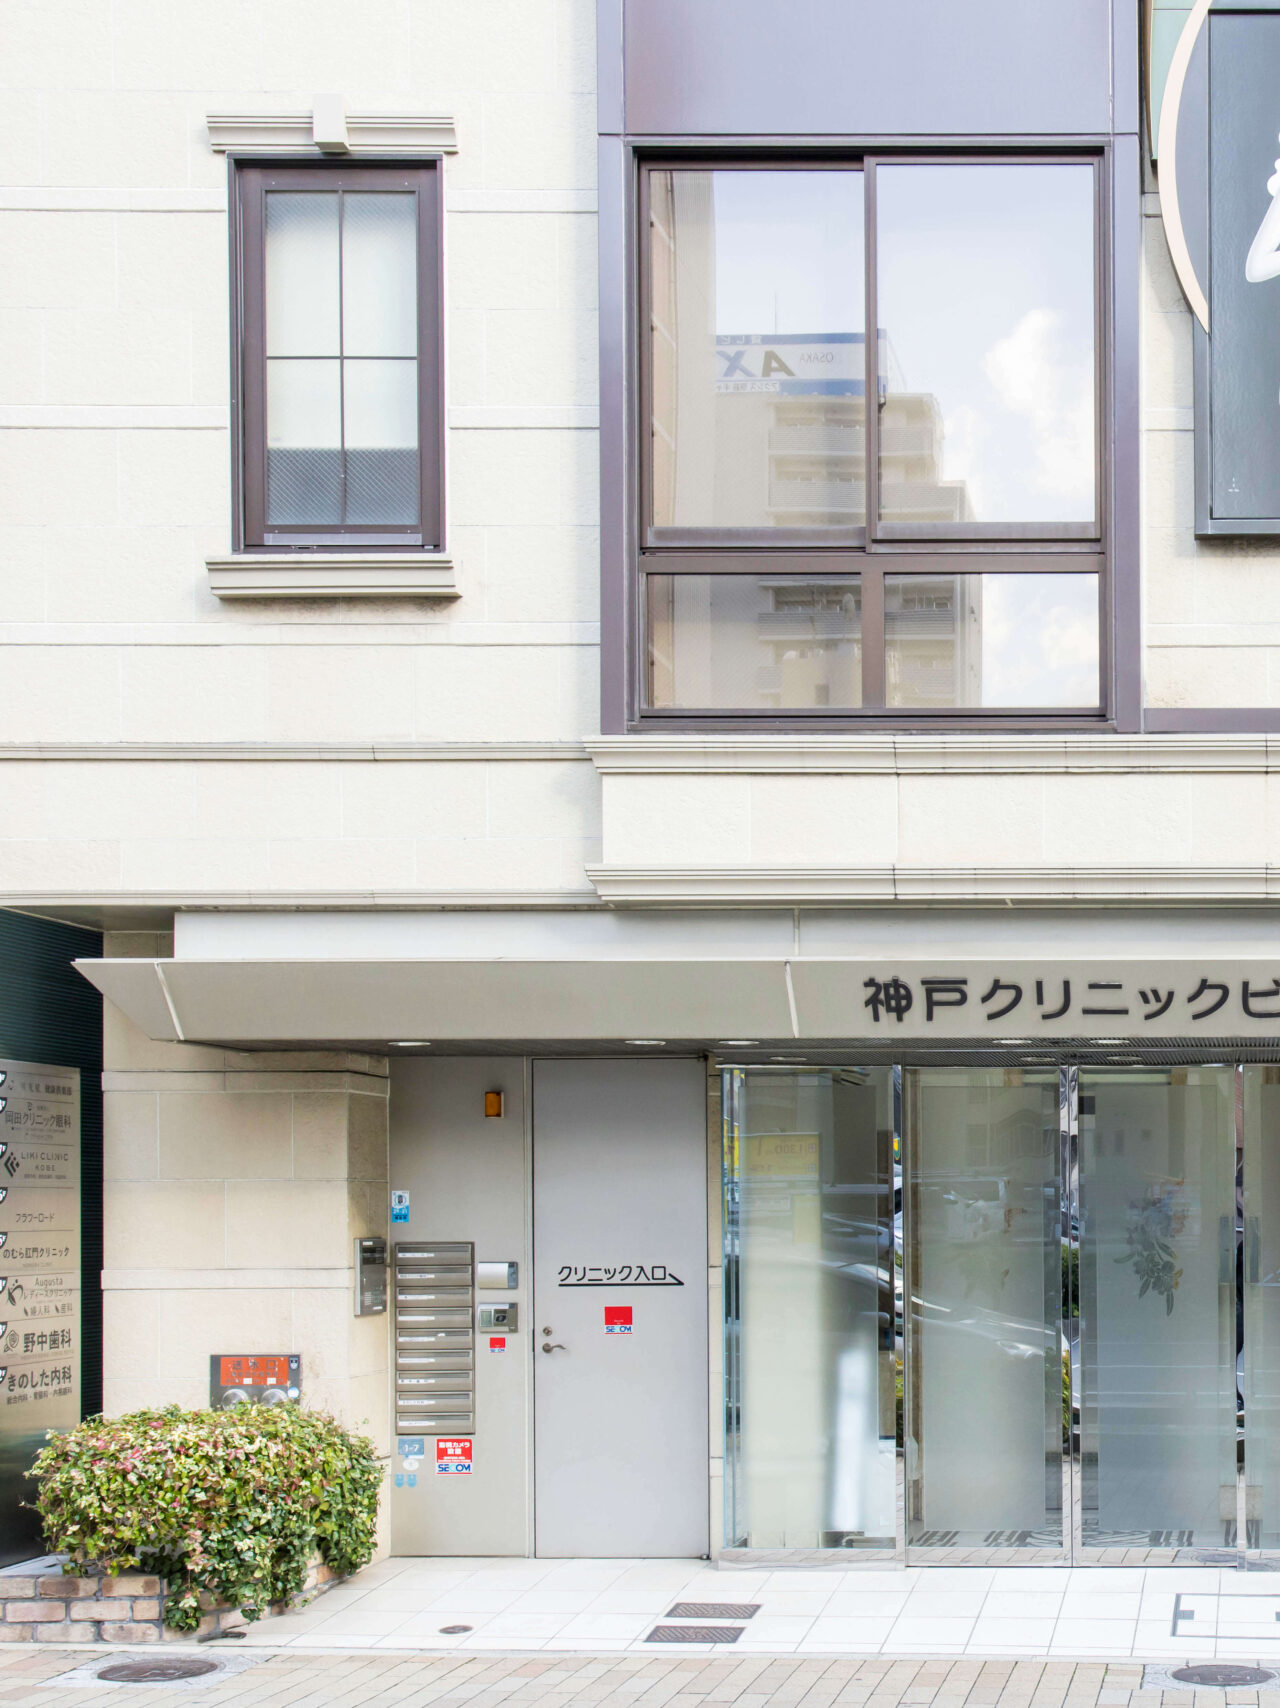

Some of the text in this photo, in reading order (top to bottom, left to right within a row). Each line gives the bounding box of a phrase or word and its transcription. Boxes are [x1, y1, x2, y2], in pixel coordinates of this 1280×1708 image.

[3, 1247, 70, 1259] のむら肛門クリニック
[558, 1265, 666, 1282] クリニック入口
[35, 1277, 63, 1288] Augusta
[23, 1328, 72, 1353] 野中歯科
[8, 1365, 72, 1392] きのした内科
[438, 1463, 471, 1472] SECOM
